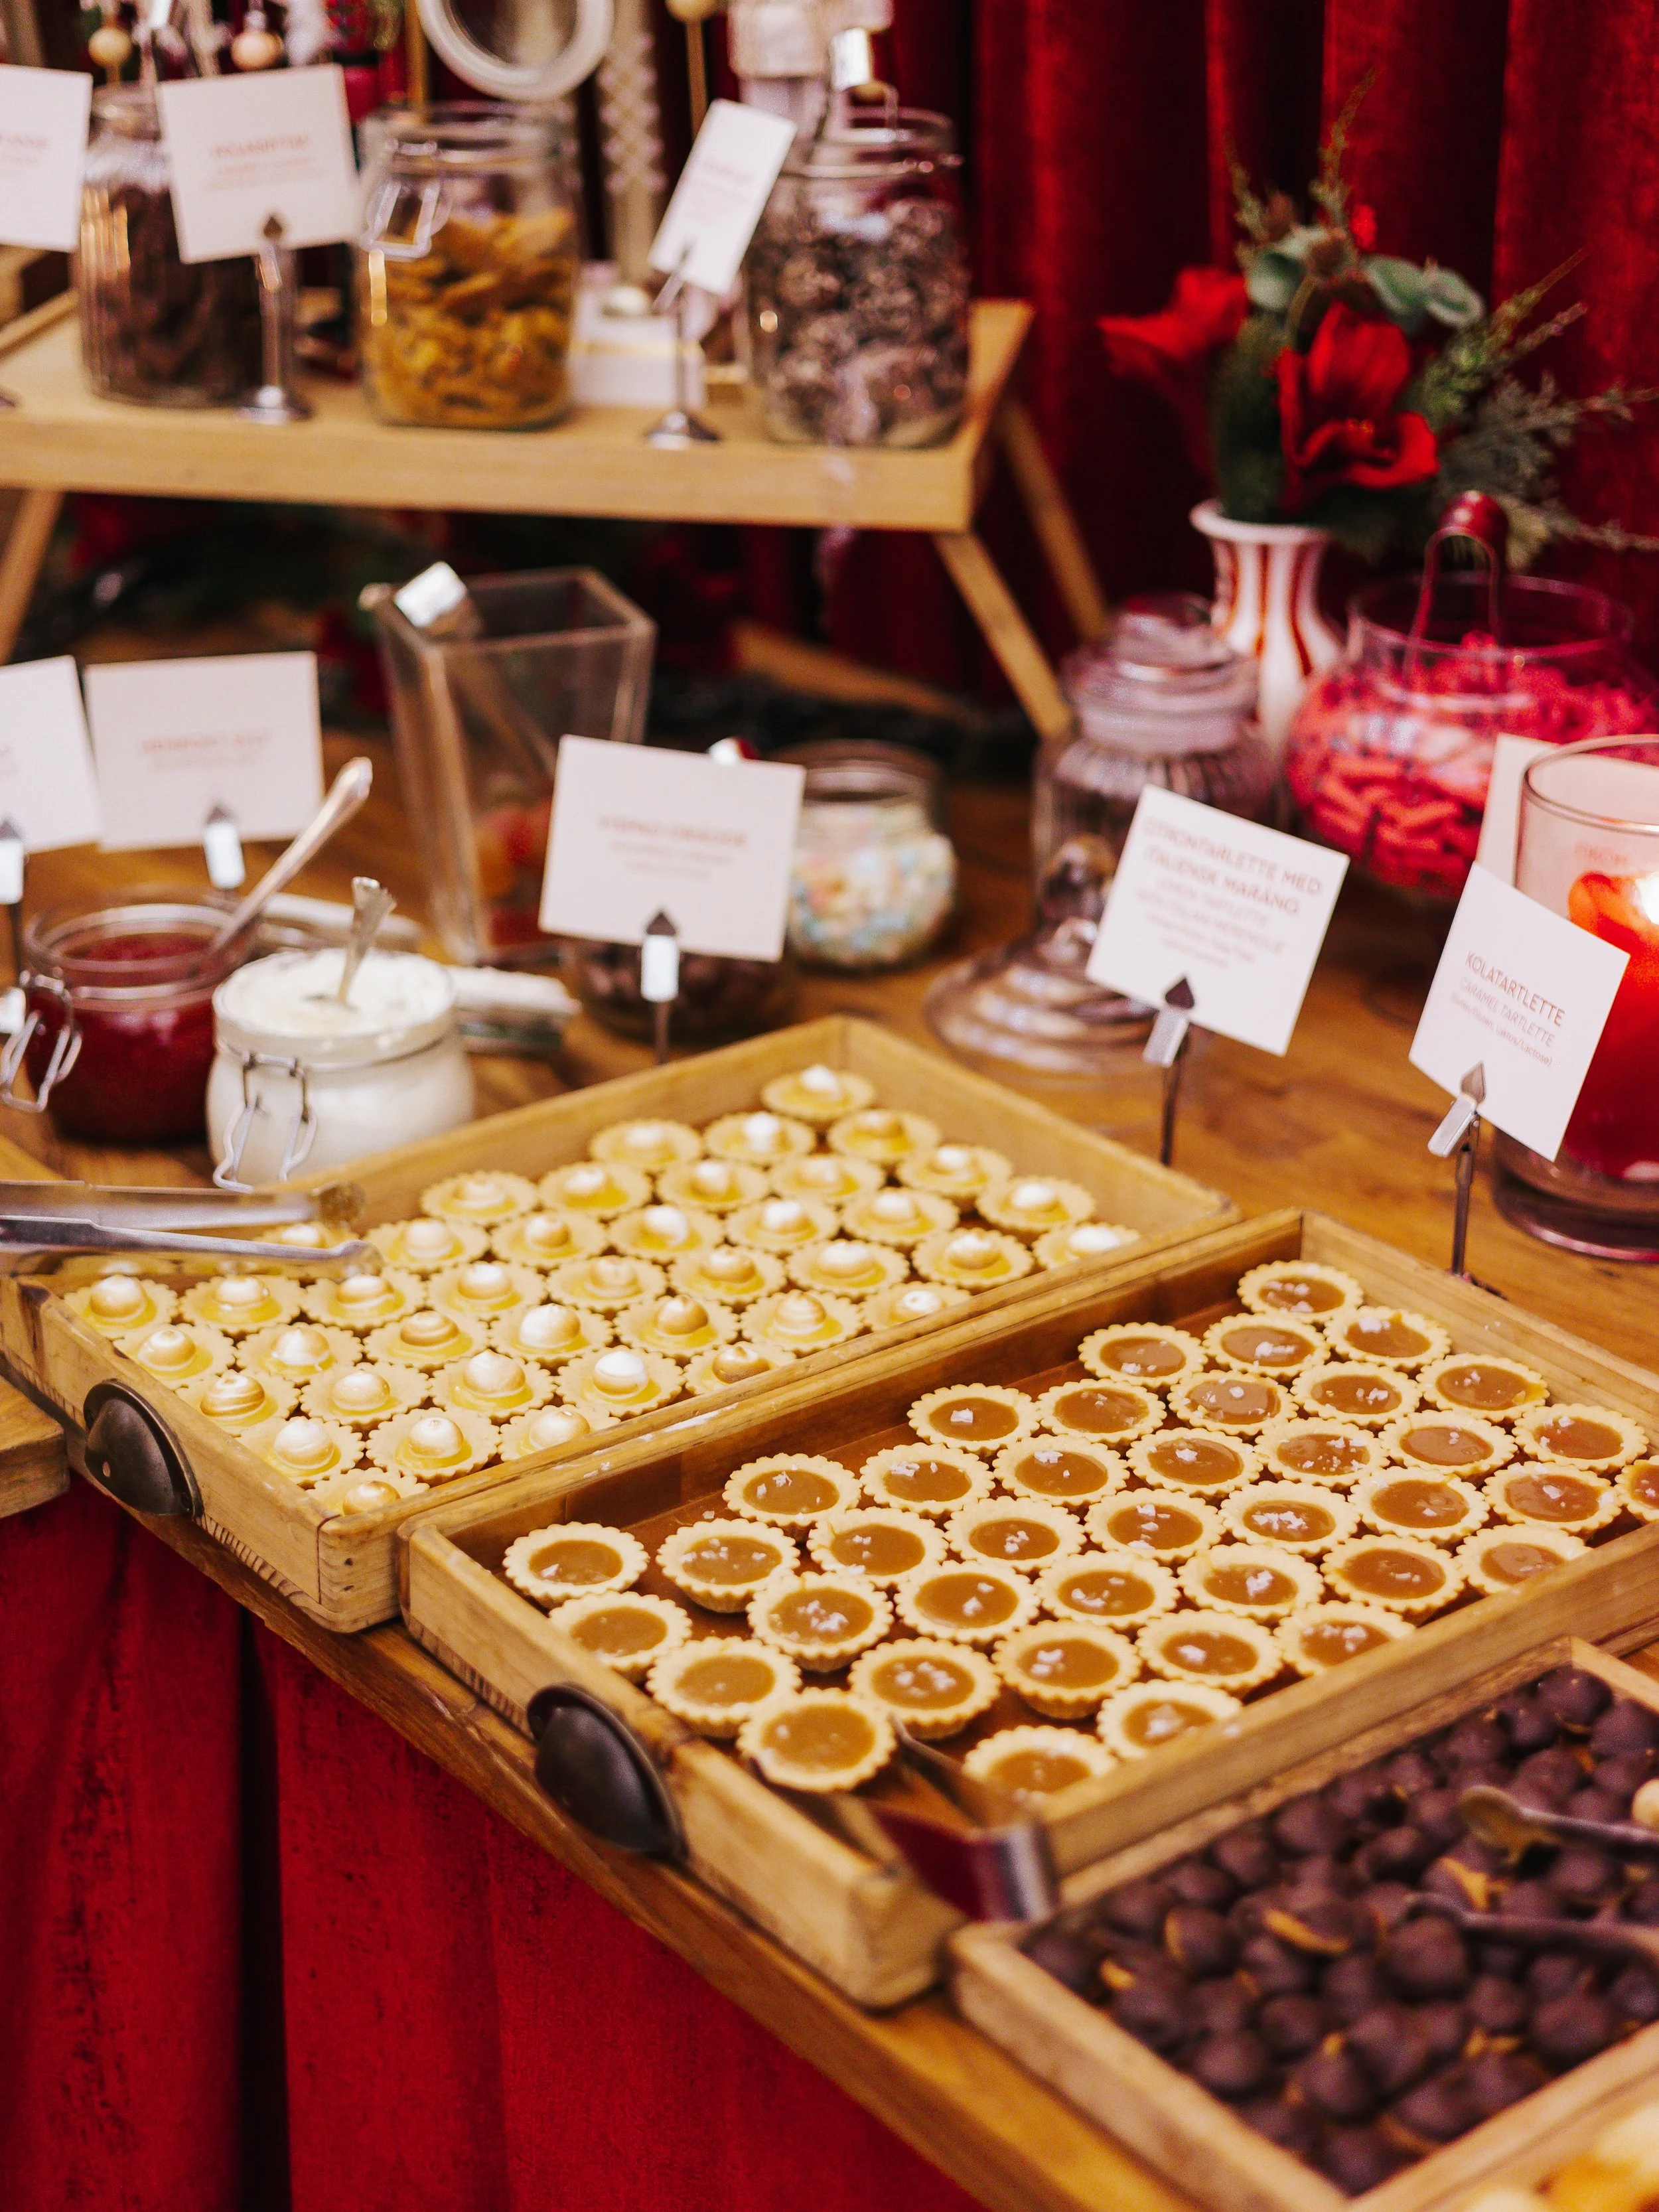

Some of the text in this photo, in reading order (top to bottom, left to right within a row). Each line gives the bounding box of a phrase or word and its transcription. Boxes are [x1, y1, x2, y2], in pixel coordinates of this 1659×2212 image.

[1283, 869, 1322, 895] MED
[1459, 975, 1555, 1048] CARAMEL TARTLETTE
[1466, 952, 1565, 1026] KOLATARTLETTE
